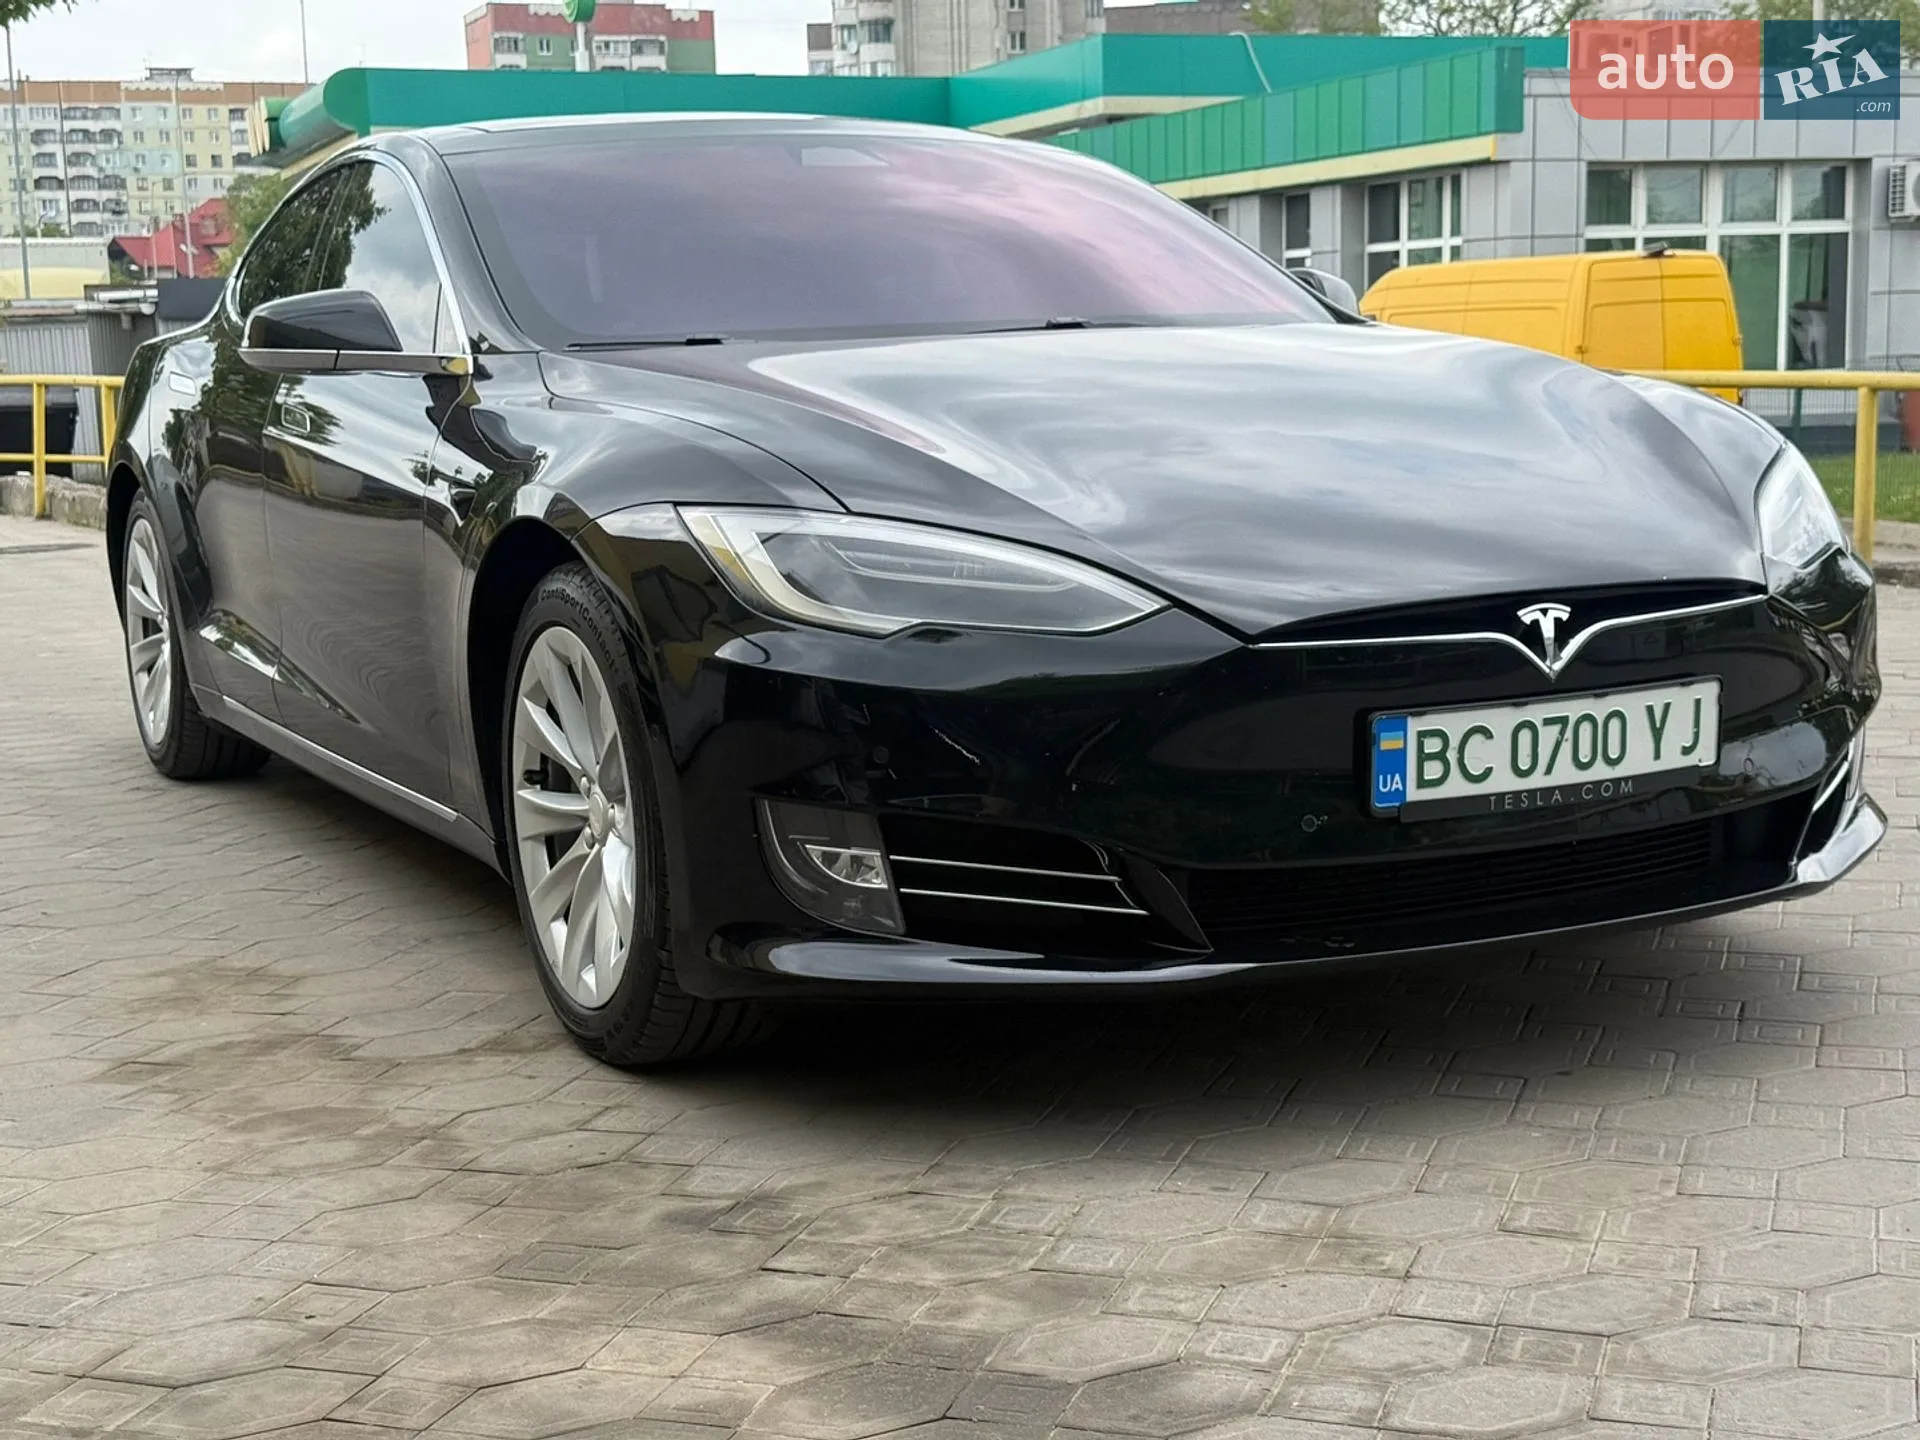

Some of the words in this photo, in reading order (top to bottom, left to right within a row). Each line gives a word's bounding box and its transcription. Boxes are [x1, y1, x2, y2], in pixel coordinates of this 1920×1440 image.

[1416, 723, 1494, 789] BC
[1510, 708, 1628, 778] 0700
[1378, 773, 1404, 793] UA
